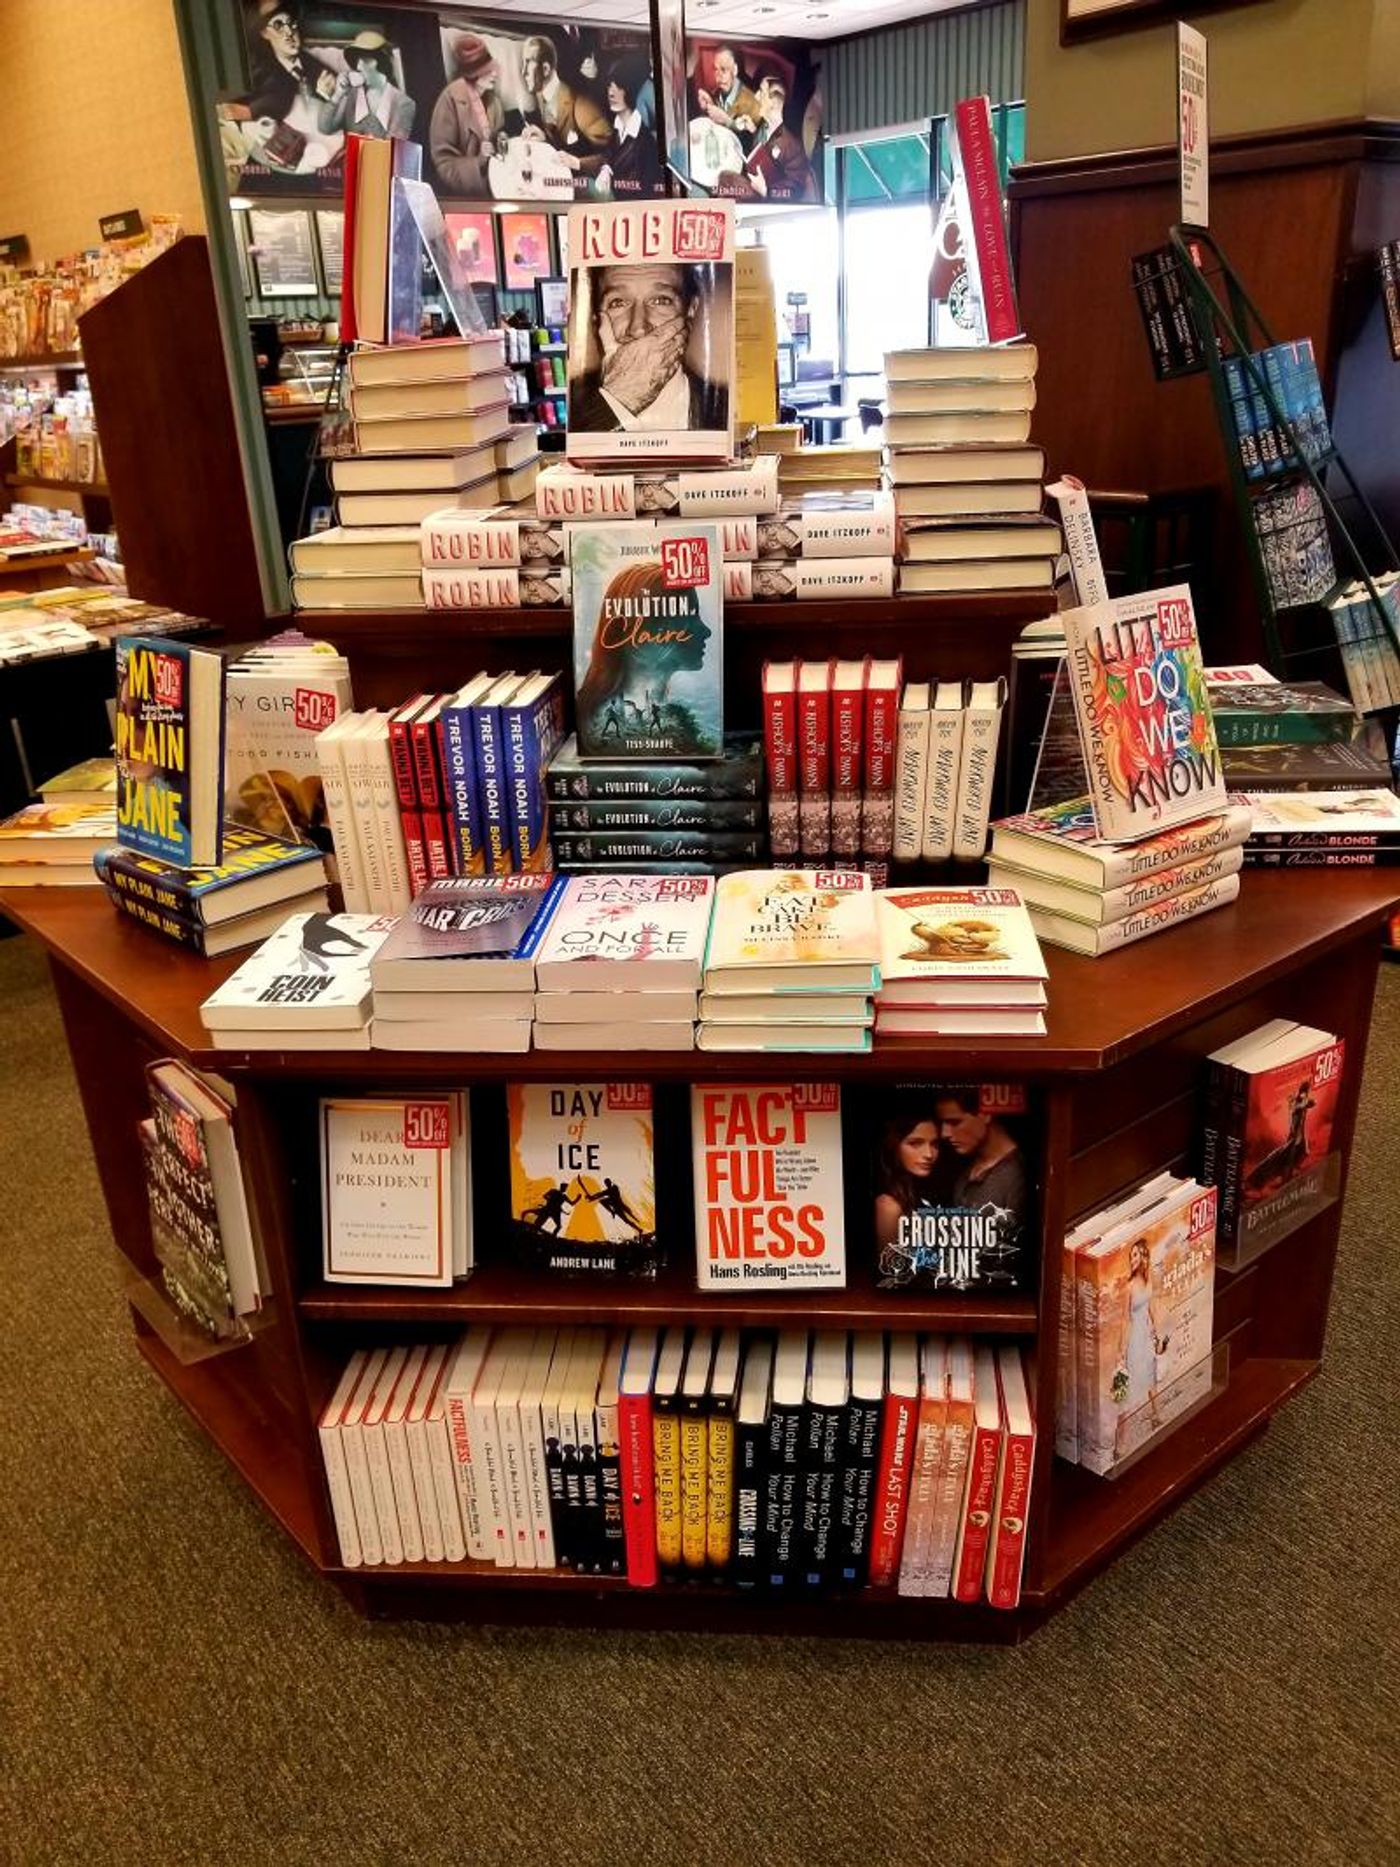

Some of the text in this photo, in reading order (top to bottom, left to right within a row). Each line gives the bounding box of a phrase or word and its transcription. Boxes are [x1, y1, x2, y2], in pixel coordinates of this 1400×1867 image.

[543, 483, 630, 515] ROBIN
[685, 488, 748, 500] DAVE ITZKOFF
[430, 530, 514, 560] ROBIN
[807, 528, 871, 538] DAVE ITZKOFF
[1064, 513, 1084, 570] DELINSKY
[1078, 512, 1097, 565] BARBARA
[665, 542, 704, 580] 50%
[802, 575, 864, 585] DAVE ITZKOFF
[431, 579, 515, 609] ROBIN
[605, 596, 689, 618] EVOLUTION
[600, 615, 695, 650] Claire
[1095, 612, 1160, 663] LITT
[1160, 603, 1190, 640] 50%
[1134, 661, 1180, 707] DO
[256, 696, 296, 712] GIR
[298, 691, 333, 724] 50%
[116, 711, 185, 773] PLAIN
[1074, 648, 1113, 804] LITTLE DO WE KNOW
[1140, 712, 1191, 756] WE
[772, 712, 786, 788] BISHOP'S PAWN
[805, 712, 819, 788] BISHOP'S PAWN
[839, 710, 853, 787] BISHOP'S PAWN
[871, 709, 885, 786] BISHOP'S PAWN
[448, 715, 473, 861] TREVOR NOAH BORN
[479, 714, 503, 859] TREVOR NOAH BORN
[509, 713, 530, 859] TREVOR NOAH BORN
[605, 776, 706, 796] EVOLUTION Claire
[1128, 756, 1217, 813] KNOW
[117, 779, 184, 843] JANE
[605, 808, 707, 827] EVOLUTION Claire
[608, 840, 707, 857] EVOLUTION Claire
[1130, 829, 1232, 873] LITTLE DO WE KNOW
[1325, 854, 1377, 864] BLONDE
[1327, 835, 1379, 846] BLONDE
[577, 891, 697, 904] DESSEN
[582, 877, 660, 889] SAR
[663, 879, 707, 893] 50%
[818, 873, 862, 889] 50%
[1127, 860, 1223, 907] LITTLE DO WE KNOW
[412, 904, 451, 932] WAR
[1122, 889, 1220, 938] LITTLE DO WE KNOW
[554, 944, 686, 954] AND FOR ALL
[561, 930, 689, 945] ONCE
[255, 989, 322, 1003] HEIST
[268, 974, 336, 990] COIN
[1314, 1049, 1342, 1085] 50%
[551, 1090, 603, 1117] DAY
[703, 1091, 806, 1146] FACT
[407, 1106, 448, 1141] 50%
[567, 1118, 589, 1143] of
[351, 1152, 415, 1166] MADAM
[558, 1144, 601, 1170] ICE
[335, 1173, 432, 1188] PRESIDENT
[705, 1150, 788, 1203] FUL
[707, 1205, 826, 1260] NESS
[899, 1216, 998, 1248] CROSSING
[1191, 1196, 1215, 1233] 50%
[550, 1257, 616, 1270] ANDREW LANE
[709, 1263, 788, 1281] Hans Rosling
[939, 1248, 981, 1279] LINE
[448, 1398, 472, 1465] FACTFULNESS
[770, 1413, 784, 1451] Pollan
[784, 1414, 800, 1463] Michael
[809, 1411, 824, 1449] Pollan
[823, 1414, 840, 1463] Michael
[848, 1407, 863, 1446] Pollan
[861, 1410, 879, 1458] Michael
[602, 1467, 618, 1490] DAY
[659, 1423, 674, 1523] BRING ME BACK
[687, 1425, 700, 1527] BRING ME BACK
[714, 1424, 728, 1525] BRING ME BACK
[974, 1438, 994, 1508] Caddyshack
[1005, 1443, 1026, 1513] Caddyshack
[605, 1502, 621, 1521] ICE
[738, 1489, 758, 1531] CROSSING
[766, 1472, 782, 1533] Your Mind
[803, 1472, 820, 1531] Your Mind
[841, 1467, 858, 1526] Your Mind
[850, 1469, 872, 1555] How to Change
[883, 1467, 905, 1538] LAST SHOT
[777, 1474, 796, 1561] How to Change
[814, 1473, 835, 1560] How to Change
